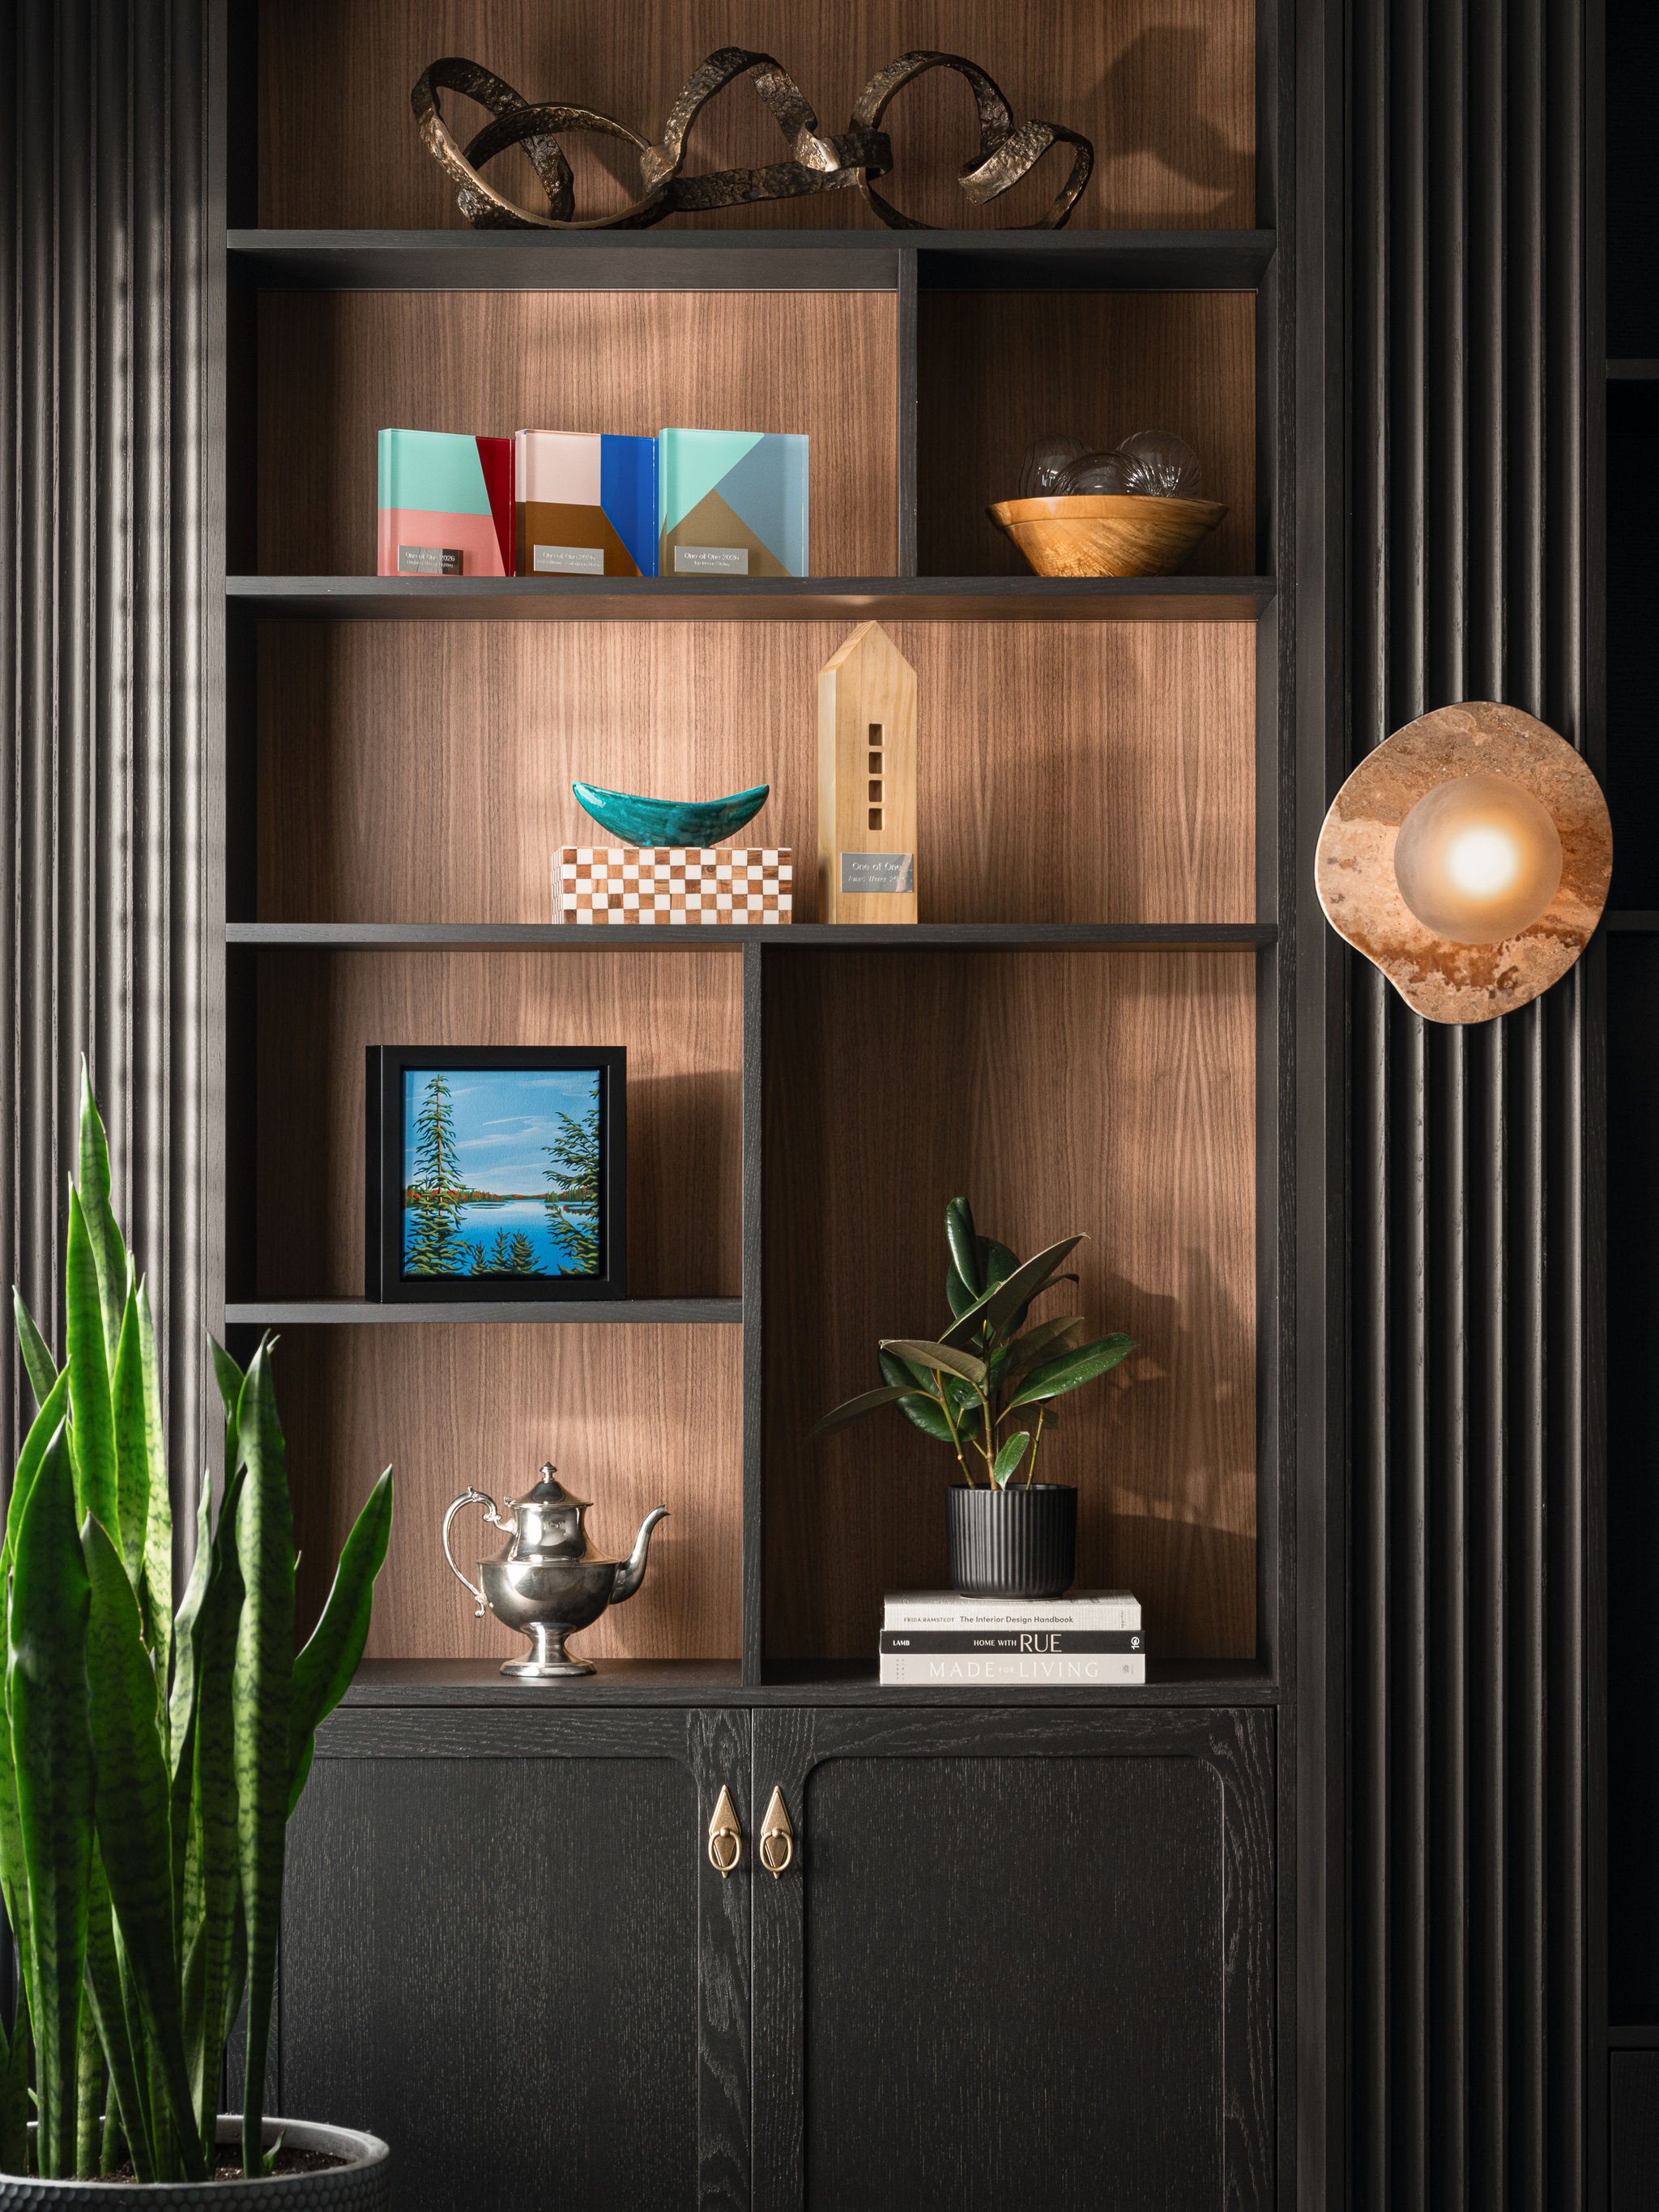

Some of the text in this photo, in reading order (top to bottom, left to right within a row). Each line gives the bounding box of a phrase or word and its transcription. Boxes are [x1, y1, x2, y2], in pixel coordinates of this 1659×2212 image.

[440, 554, 455, 562] 2026
[852, 862, 902, 871] One of One
[1006, 1616, 1032, 1625] Design
[1020, 1633, 1062, 1652] RUE
[929, 1662, 995, 1677] MADE
[1019, 1662, 1098, 1677] LIVING
